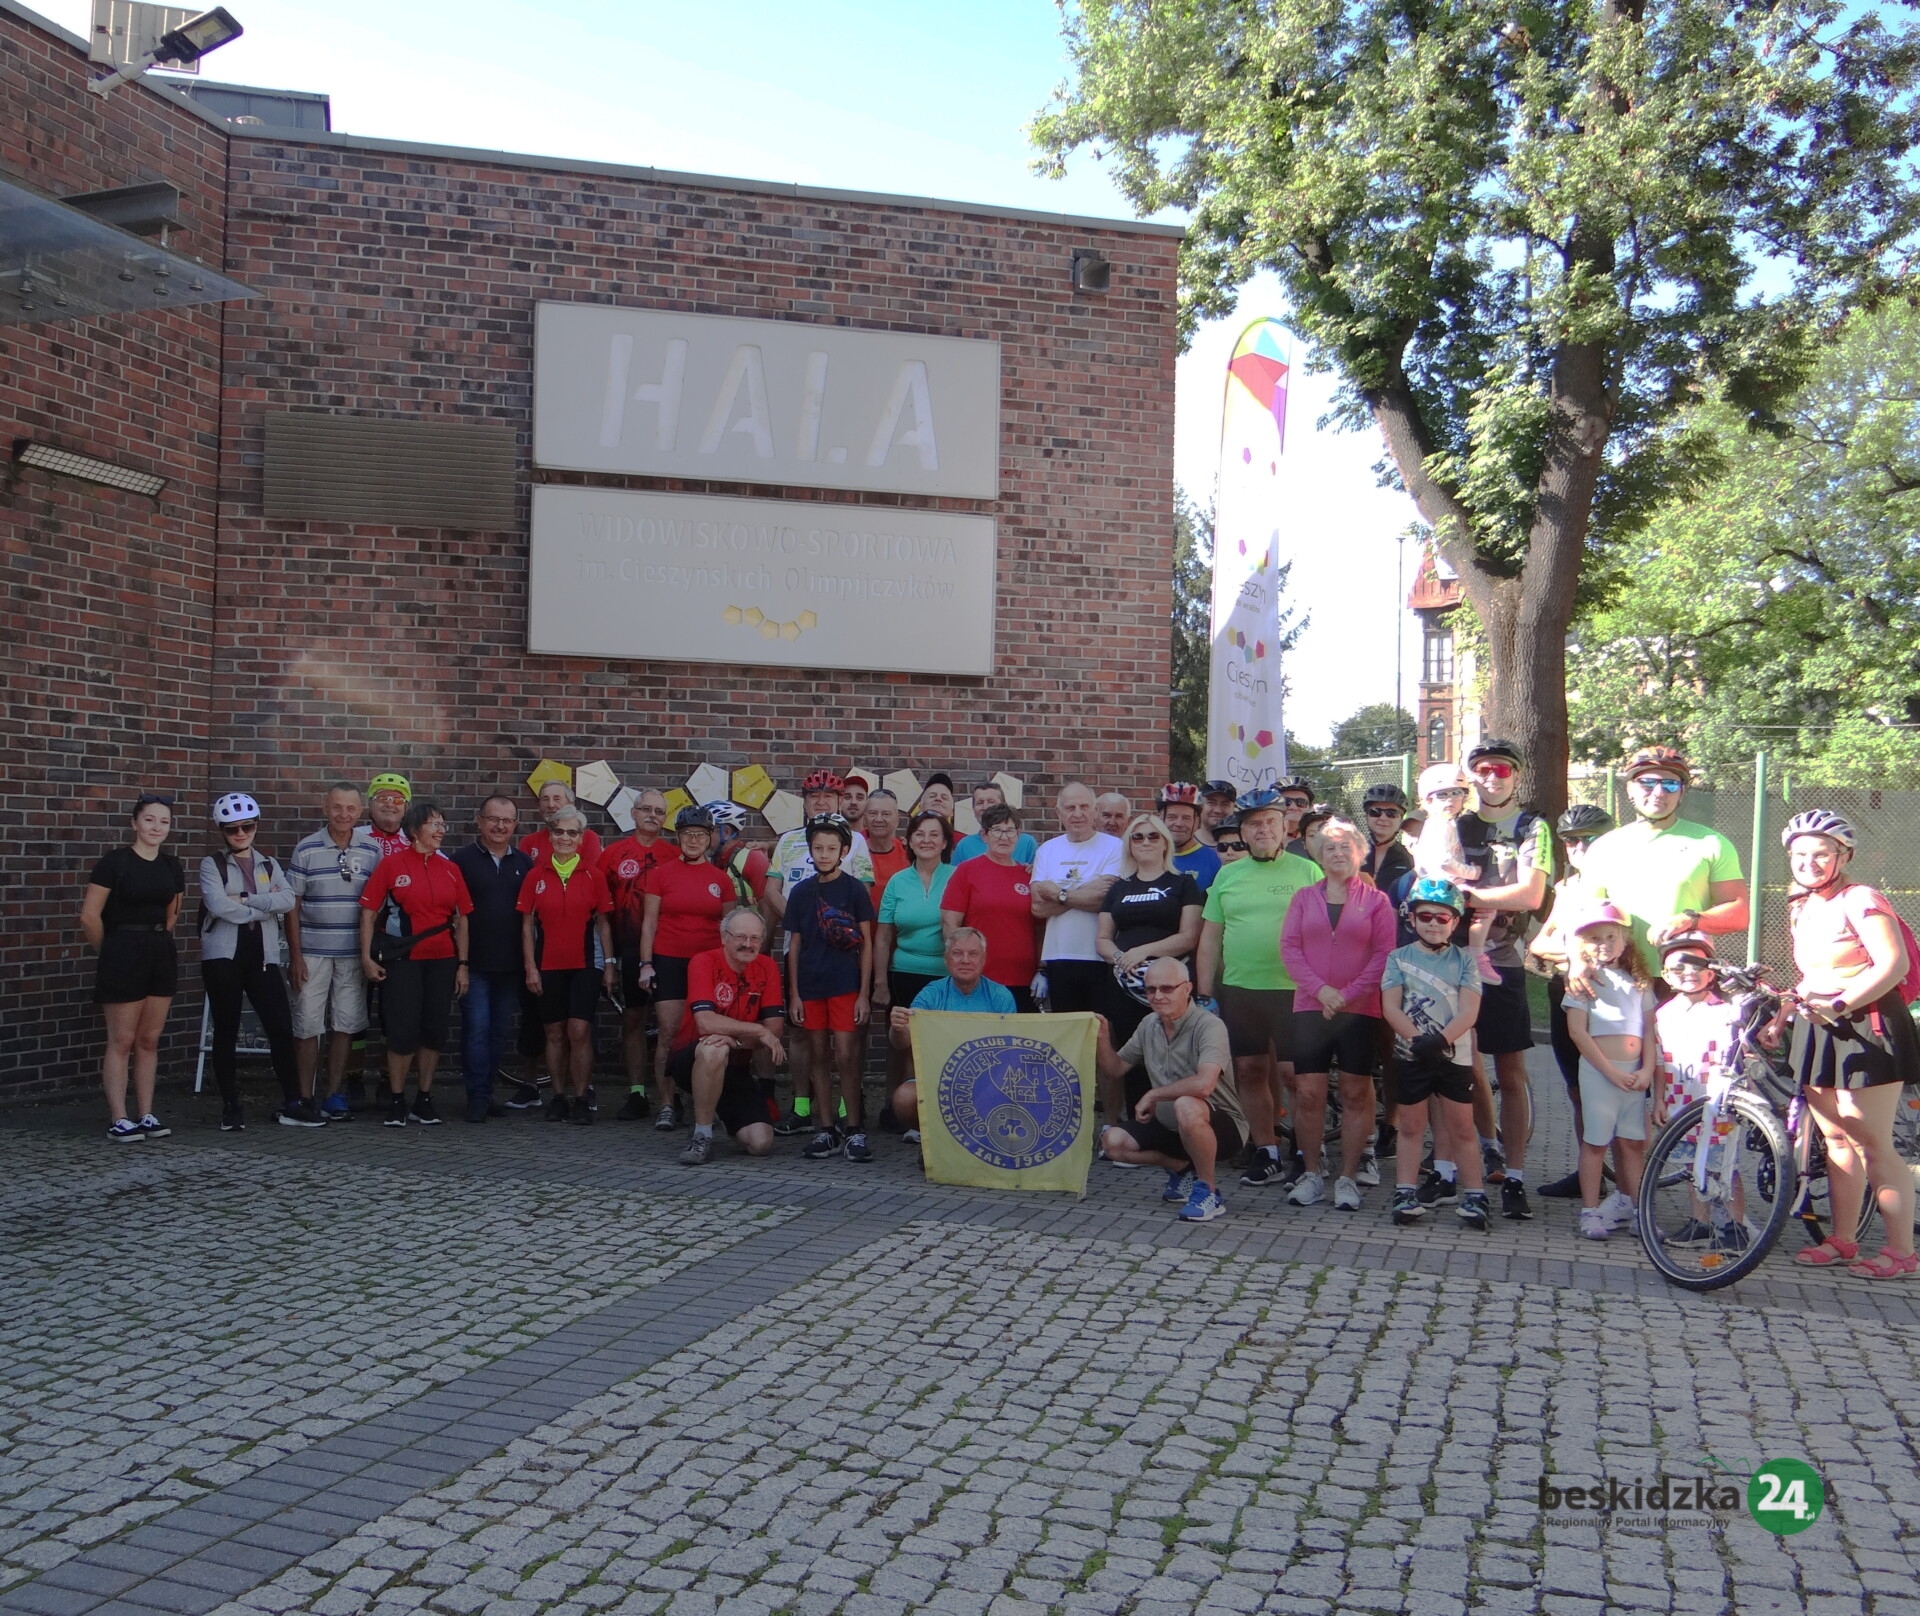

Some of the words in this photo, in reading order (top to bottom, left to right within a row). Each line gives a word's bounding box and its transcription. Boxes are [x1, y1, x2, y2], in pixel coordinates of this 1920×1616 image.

[599, 333, 939, 471] HALA
[576, 511, 958, 568] WIDOWISKOWO-SPORTOWA
[576, 554, 614, 581] im.
[619, 557, 772, 592] Cieszyńskich
[784, 567, 955, 601] Olimpijczyków
[1122, 893, 1159, 903] PUMA
[973, 1037, 1006, 1048] KLUB
[1014, 1148, 1055, 1168] 1966
